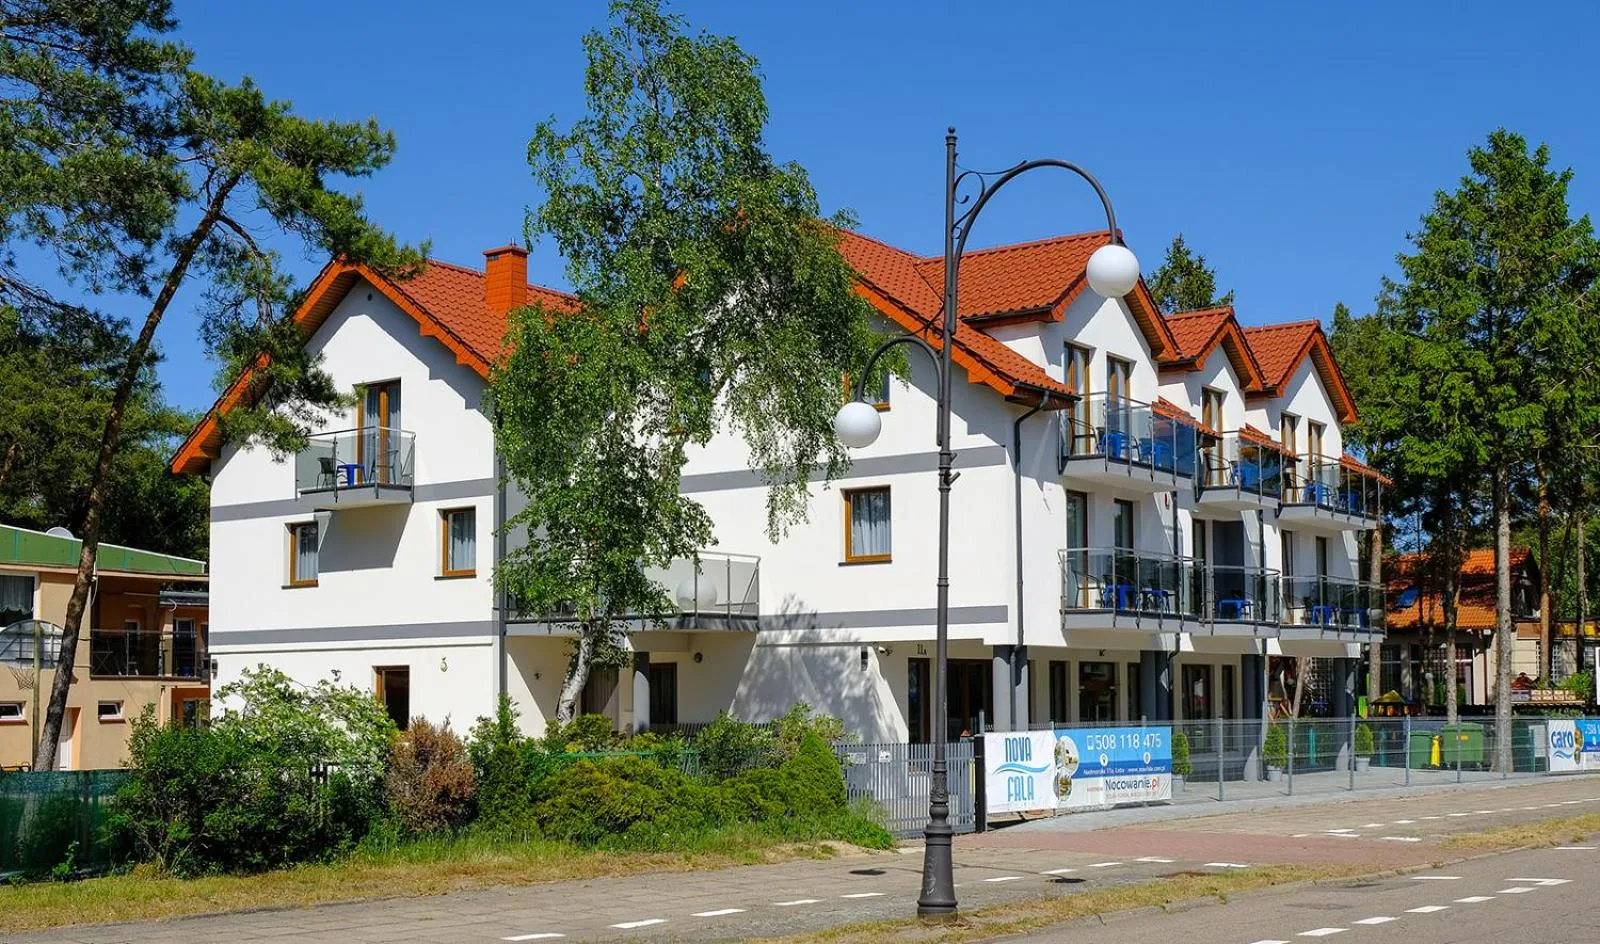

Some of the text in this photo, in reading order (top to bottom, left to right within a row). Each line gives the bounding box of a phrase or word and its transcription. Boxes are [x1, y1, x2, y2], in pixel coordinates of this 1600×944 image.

[1095, 733, 1161, 750] 508 118 475
[1551, 731, 1574, 748] caro
[1005, 737, 1032, 762] NOVA
[1008, 775, 1034, 801] FALA
[1105, 776, 1160, 790] Nocowanie.pl
